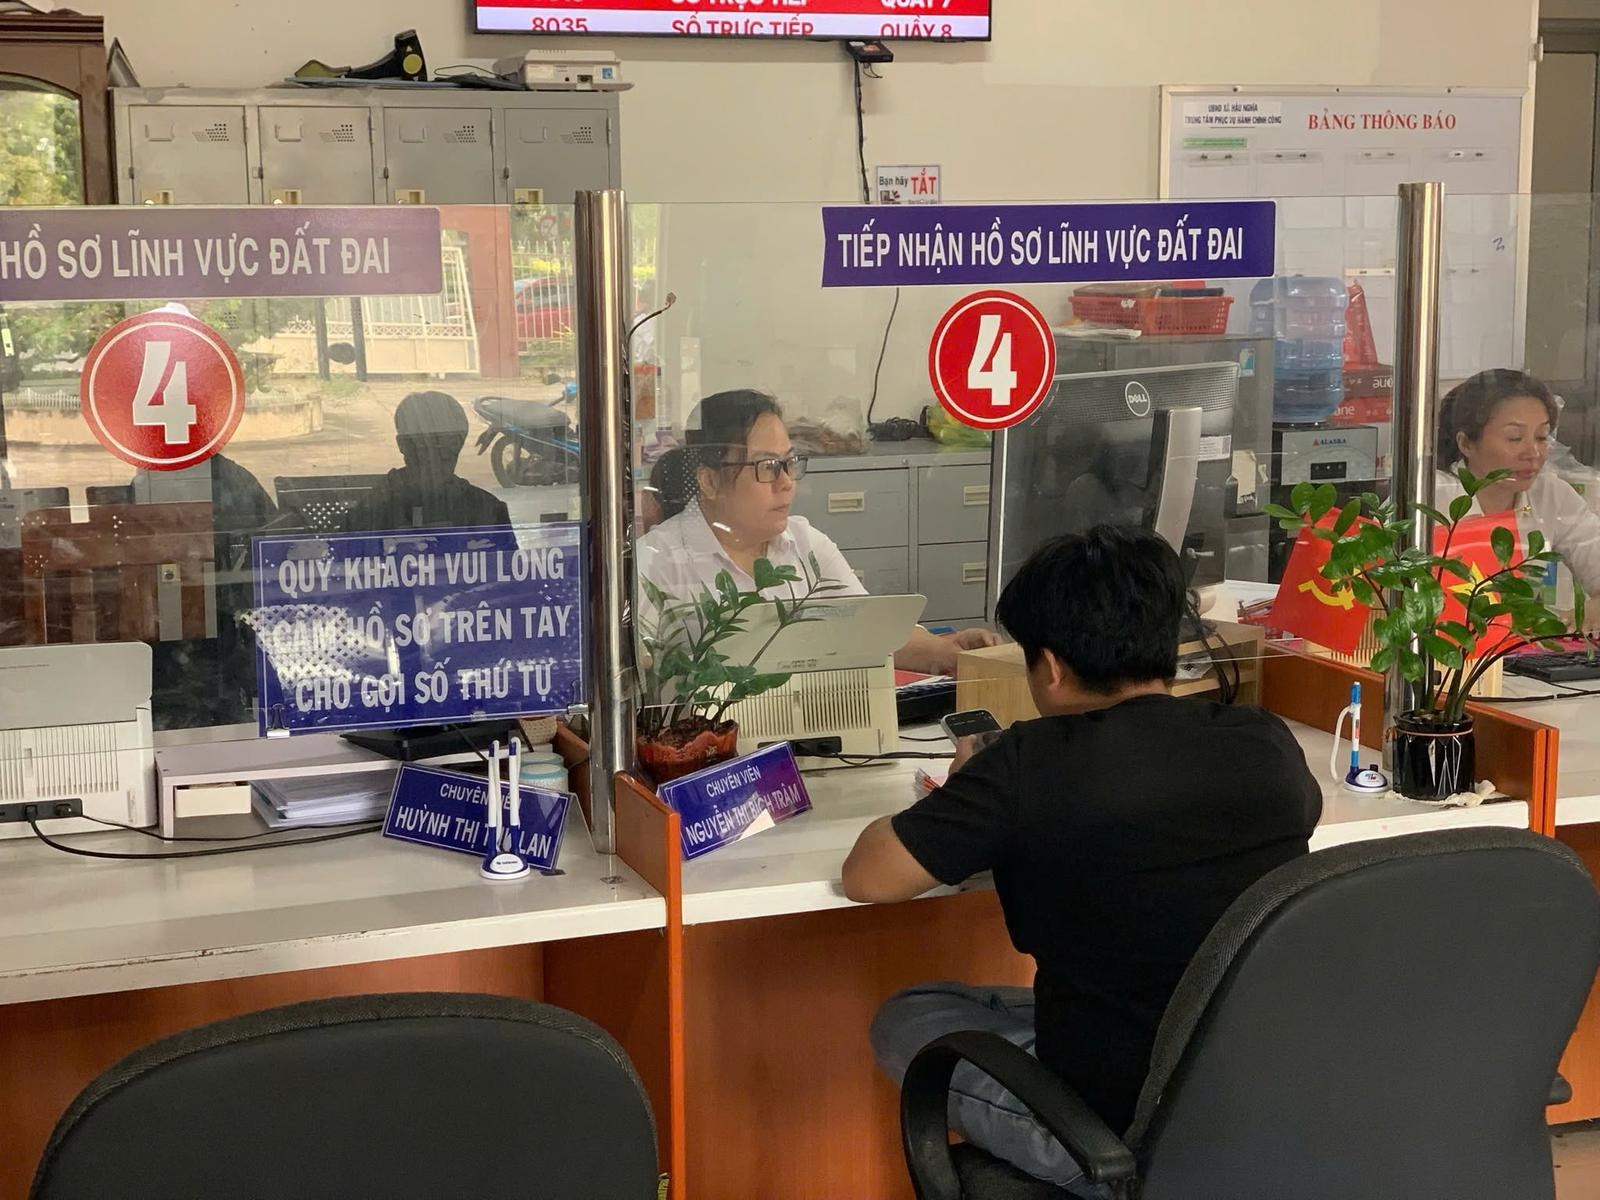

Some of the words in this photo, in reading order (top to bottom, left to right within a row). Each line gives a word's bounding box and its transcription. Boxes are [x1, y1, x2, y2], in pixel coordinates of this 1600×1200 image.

[532, 17, 588, 32] 8035
[1308, 108, 1356, 130] BẢNG
[1360, 109, 1417, 130] THÔNG
[1422, 109, 1457, 130] BÁO
[879, 175, 894, 187] Bạn
[895, 174, 908, 188] hãy
[911, 168, 937, 195] TẮT
[1, 223, 47, 279] HỒ
[58, 234, 101, 279] SƠ
[112, 229, 184, 277] LĨNH
[194, 233, 260, 283] VỰC
[269, 221, 331, 276] ĐẤT
[341, 237, 390, 275] ĐAI
[837, 219, 891, 268] TIẾP
[898, 223, 963, 274] NHẬN
[971, 216, 1004, 266] HỒ
[1010, 224, 1042, 265] SƠ
[1049, 222, 1098, 265] LĨNH
[1105, 224, 1151, 270] VỰC
[1157, 214, 1202, 262] ĐẤT
[1207, 227, 1243, 260] ĐAI
[967, 314, 1017, 405] 4
[132, 340, 197, 444] 4
[1128, 394, 1147, 403] DELL
[344, 546, 436, 591] KHÁCH
[444, 551, 487, 585] VUI
[347, 601, 386, 650] HỒ
[395, 609, 433, 647] SƠ
[439, 601, 513, 643] TRÊN
[520, 605, 572, 638] TAY
[360, 673, 405, 713] GỌI
[414, 657, 451, 704] SỐ
[457, 657, 512, 701] THỨ
[517, 658, 554, 702] TỰ
[440, 783, 489, 807] CHUYÊN
[706, 772, 742, 798] CHUYÊN
[741, 765, 762, 786] VIÊN
[395, 804, 451, 837] HUỲNH
[454, 817, 480, 849] THỊ
[518, 830, 552, 859] LAN
[685, 804, 735, 846] NGUYỄN
[772, 782, 801, 809] TRÂM
